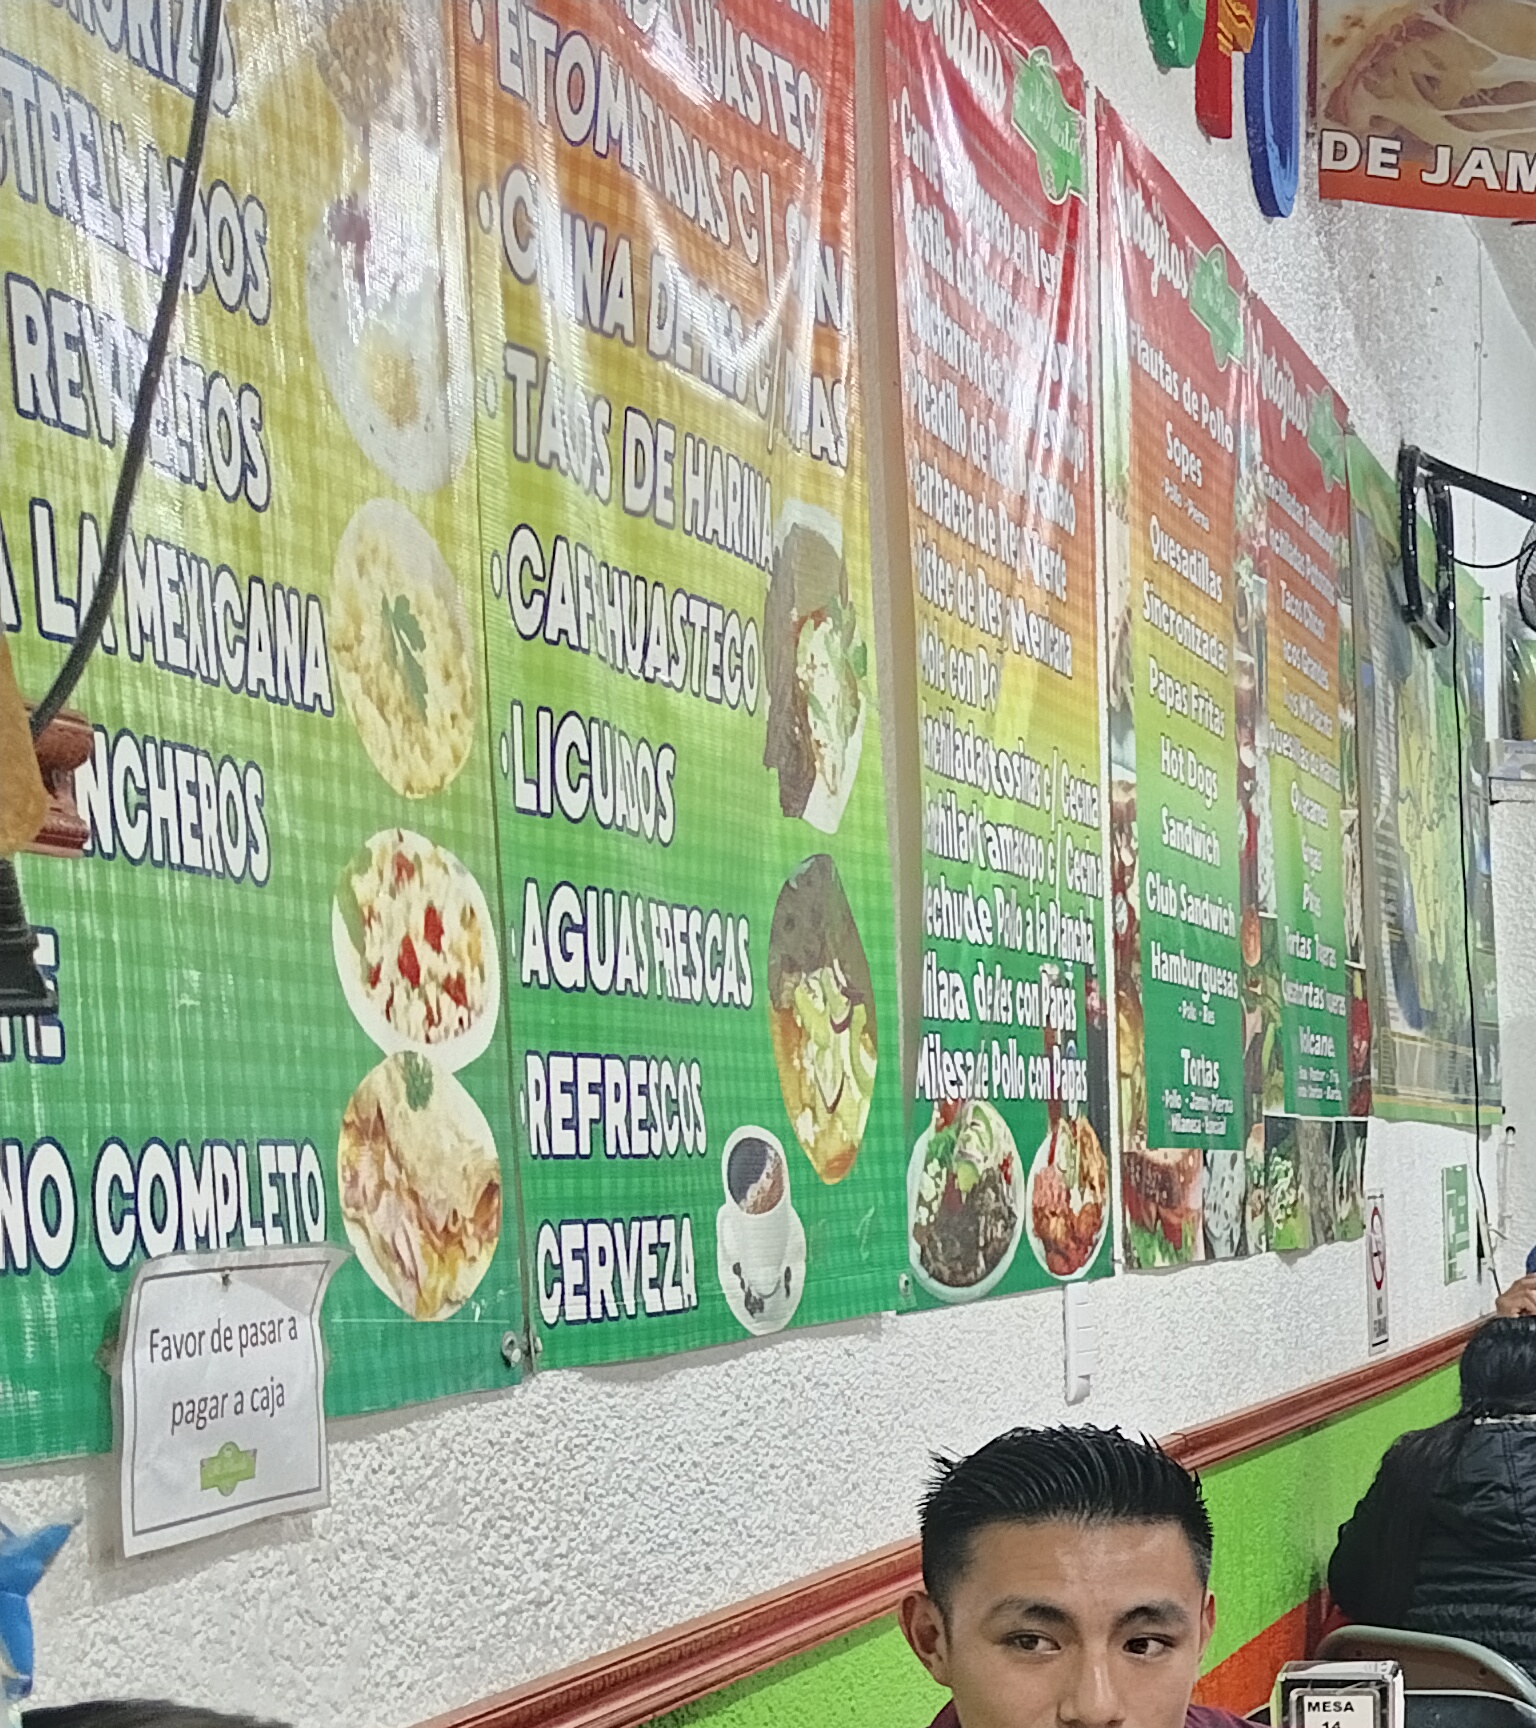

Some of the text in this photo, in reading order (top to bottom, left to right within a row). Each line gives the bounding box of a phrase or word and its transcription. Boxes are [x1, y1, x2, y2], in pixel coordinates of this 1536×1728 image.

[1318, 127, 1402, 182] DE
[1128, 317, 1180, 402] Flautas
[1181, 375, 1200, 425] de
[1201, 392, 1235, 454] Pollo
[970, 405, 988, 476] de
[1165, 420, 1203, 488] Sopes
[621, 405, 773, 576] DE HARINA
[977, 492, 998, 560] de
[956, 556, 976, 628] de
[1149, 512, 1223, 605] Quesadillas
[1142, 577, 1229, 677] Sincronizadas
[949, 645, 977, 708] con
[1148, 653, 1189, 719] Papas
[1190, 681, 1226, 741] Fritas
[510, 702, 677, 847] LICUADOS
[1160, 732, 1186, 786] Hot
[1186, 747, 1219, 811] Dogs
[1160, 802, 1221, 868] Sandwich
[1025, 905, 1034, 955] a
[1034, 893, 1049, 956] la
[1048, 896, 1096, 966] Plancha
[1145, 870, 1237, 938] Club Sandwich
[520, 878, 755, 1010] AGUAS FRESCAS
[1149, 939, 1240, 1004] Hamburguesas
[1015, 979, 1040, 1028] con
[1040, 966, 1078, 1046] Papas
[524, 1050, 708, 1160] REFRESCOS
[991, 1037, 1026, 1101] Pollo
[1027, 1054, 1052, 1101] con
[1051, 1044, 1089, 1120] Papas
[1180, 1047, 1220, 1090] Tortas
[91, 1137, 327, 1268] COMPLETO
[536, 1214, 698, 1326] CERVEZA
[149, 1315, 299, 1364] Favor de pasar a
[171, 1375, 286, 1437] pagar a caja
[1306, 1700, 1356, 1713] MESA
